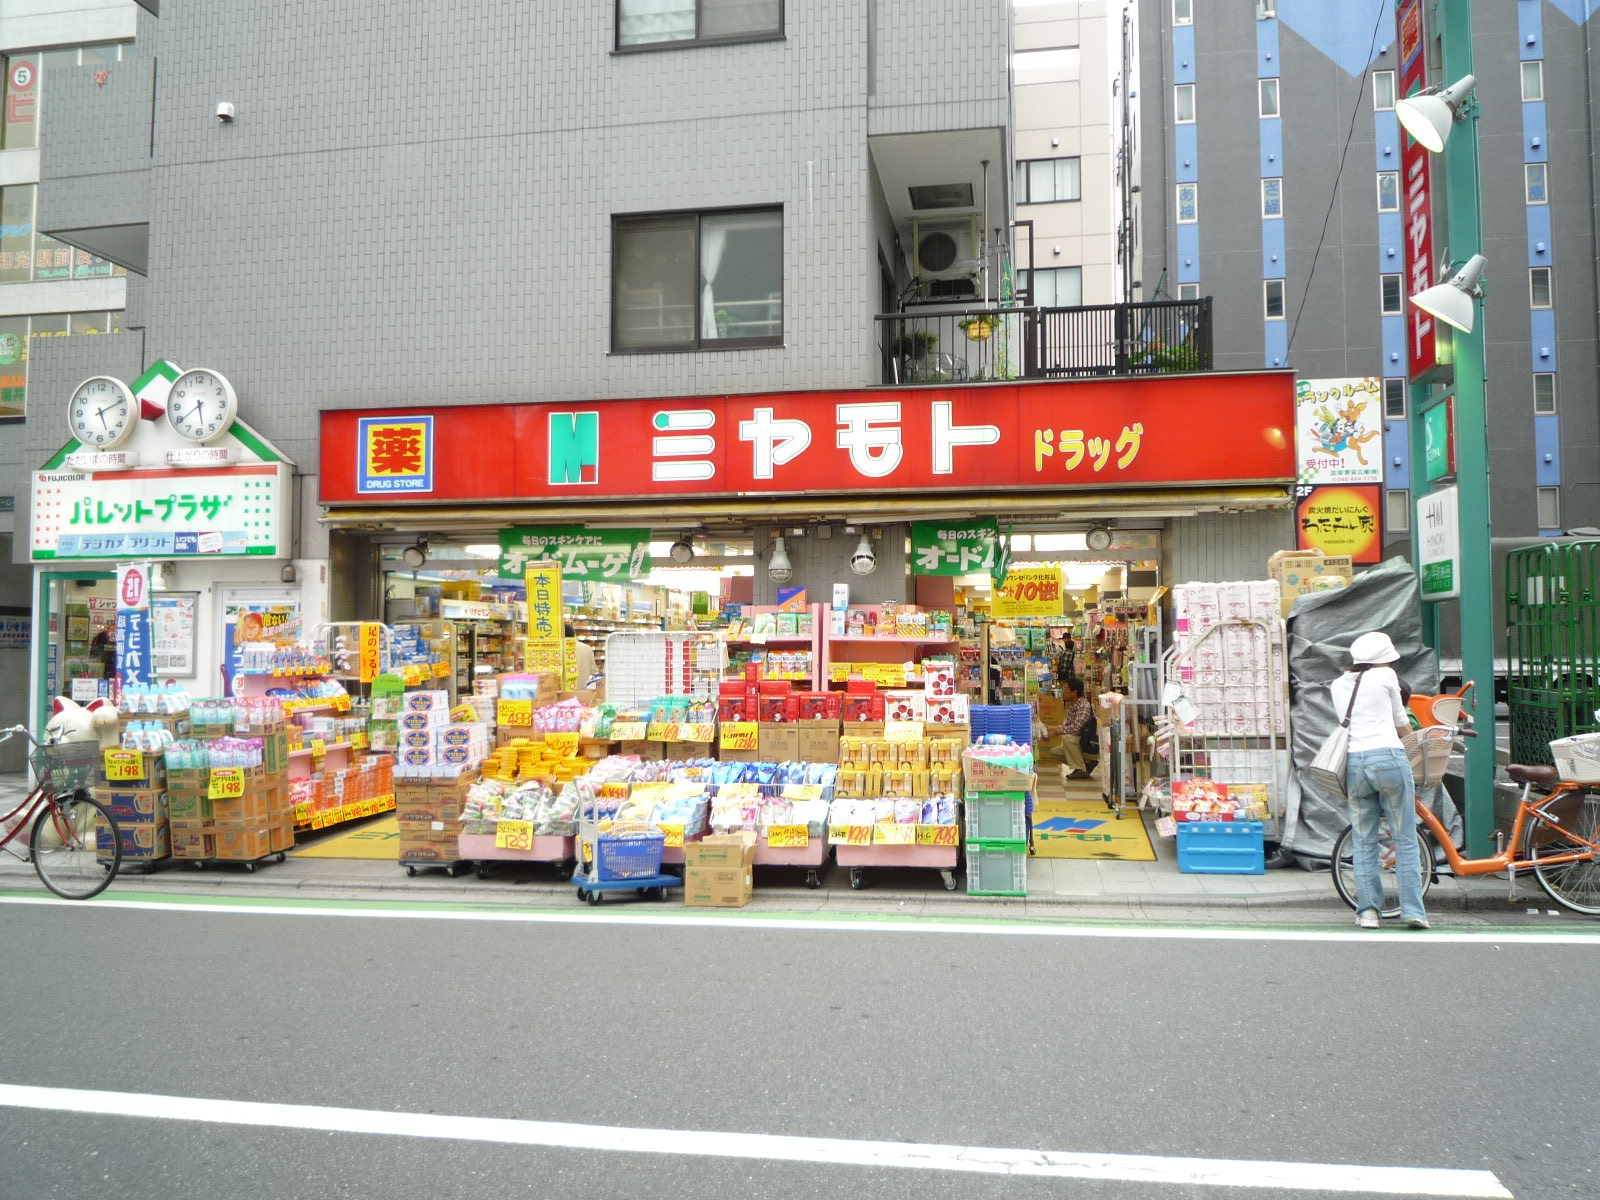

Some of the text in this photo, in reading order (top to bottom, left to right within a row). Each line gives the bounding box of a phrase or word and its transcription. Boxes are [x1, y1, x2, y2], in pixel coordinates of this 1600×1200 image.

[184, 379, 193, 388] 11
[195, 375, 205, 384] 12
[210, 378, 213, 387] 1
[87, 386, 95, 395] 11
[97, 383, 106, 392] 12
[111, 386, 115, 394] 1
[216, 387, 223, 396] 2
[176, 390, 186, 398] 10
[79, 397, 88, 405] 10
[117, 395, 124, 403] 2
[174, 403, 181, 411] 9
[219, 400, 226, 409] 3
[76, 409, 83, 418] 9
[120, 408, 126, 416] 3
[176, 415, 184, 424] 8
[215, 413, 223, 421] 4
[78, 422, 85, 430] 8
[115, 420, 123, 428] 4
[208, 423, 216, 431] 5
[185, 425, 192, 433] 7
[196, 427, 203, 436] 6
[87, 431, 93, 439] 7
[97, 434, 104, 443] 6
[109, 430, 116, 438] 5
[652, 400, 1001, 482] ミヤモト
[371, 428, 422, 474] 薬
[1034, 422, 1144, 472] ドラッグ
[65, 453, 128, 466] ただいまの時間
[166, 449, 229, 463] 仕上がりの時間
[47, 474, 86, 483] FUJICOLOR
[366, 479, 424, 490] DRUG STORE
[1296, 486, 1313, 497] 2F
[69, 494, 234, 526] パレットプラザ
[522, 535, 603, 546] 毎日のスキンケアに
[367, 626, 378, 680] 足のつる人
[507, 711, 531, 725] 488
[119, 765, 139, 777] 198
[221, 781, 241, 794] 198
